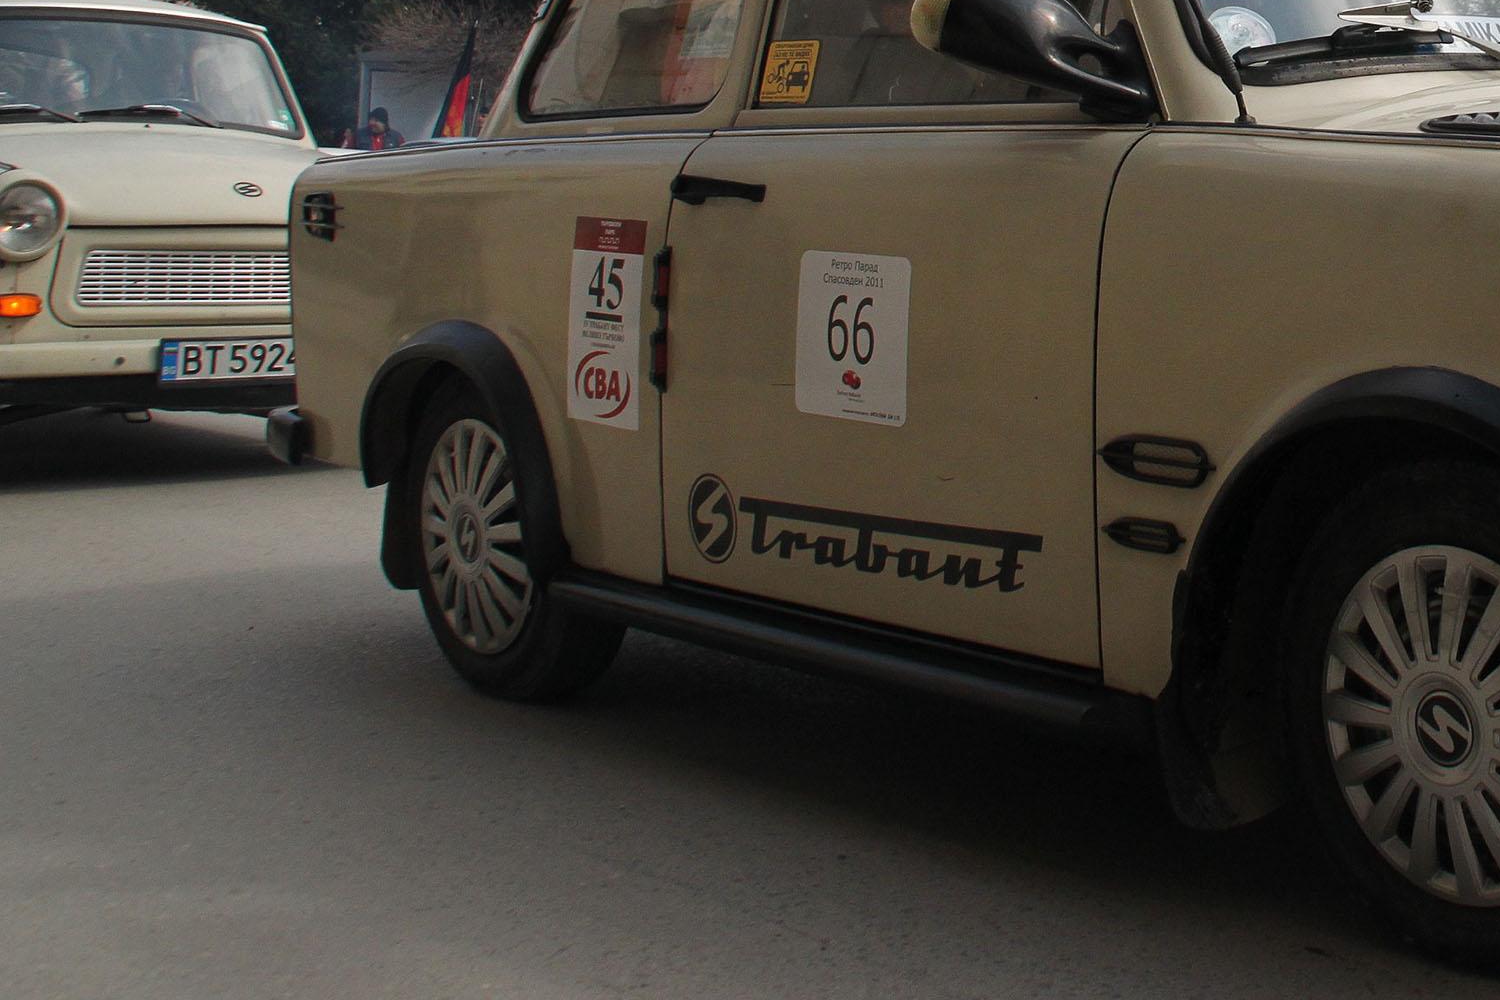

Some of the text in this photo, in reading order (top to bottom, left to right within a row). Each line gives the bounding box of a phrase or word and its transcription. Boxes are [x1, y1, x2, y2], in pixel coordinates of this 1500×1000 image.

[588, 255, 626, 311] 45
[865, 275, 884, 288] 2011
[827, 294, 875, 365] 66
[163, 366, 177, 376] BG
[182, 344, 225, 375] BT
[584, 366, 622, 402] CBA
[739, 496, 1043, 593] Trabant
